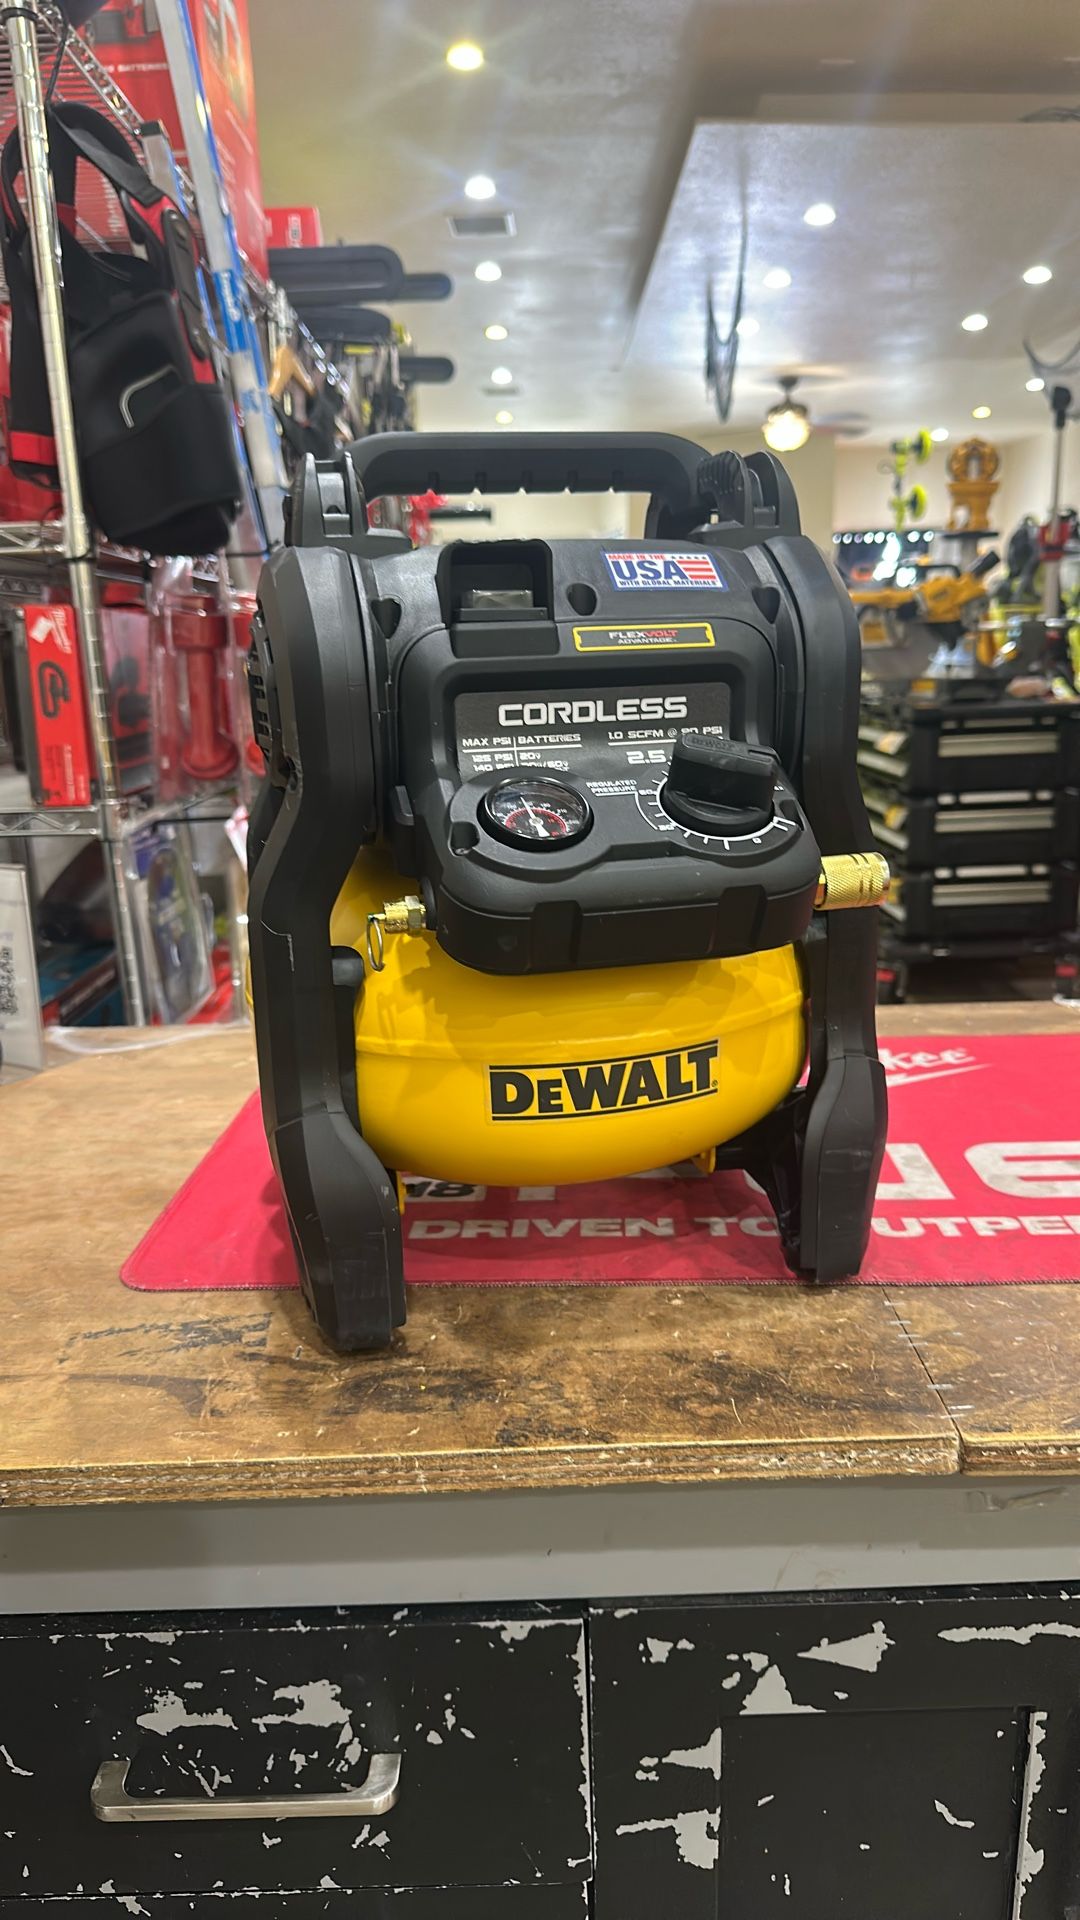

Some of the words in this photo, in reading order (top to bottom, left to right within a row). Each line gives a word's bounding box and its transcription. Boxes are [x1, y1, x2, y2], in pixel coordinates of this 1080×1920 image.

[610, 560, 689, 580] USA
[608, 630, 678, 640] FLEXVOLT
[498, 696, 687, 726] CORDLESS
[627, 729, 664, 739] SCFM
[667, 727, 678, 738] @
[702, 725, 723, 735] PSI
[462, 738, 489, 747] MAX
[492, 736, 512, 745] PSI
[517, 733, 581, 744] BATTERIES
[472, 754, 491, 762] 125
[494, 753, 513, 761] PSI
[625, 749, 667, 764] 2.5
[473, 763, 493, 771] 140
[585, 779, 637, 789] REGULATED
[590, 785, 637, 793] PRESSURE
[489, 1045, 717, 1115] DEWALT
[408, 1218, 674, 1239] DRIVEN
